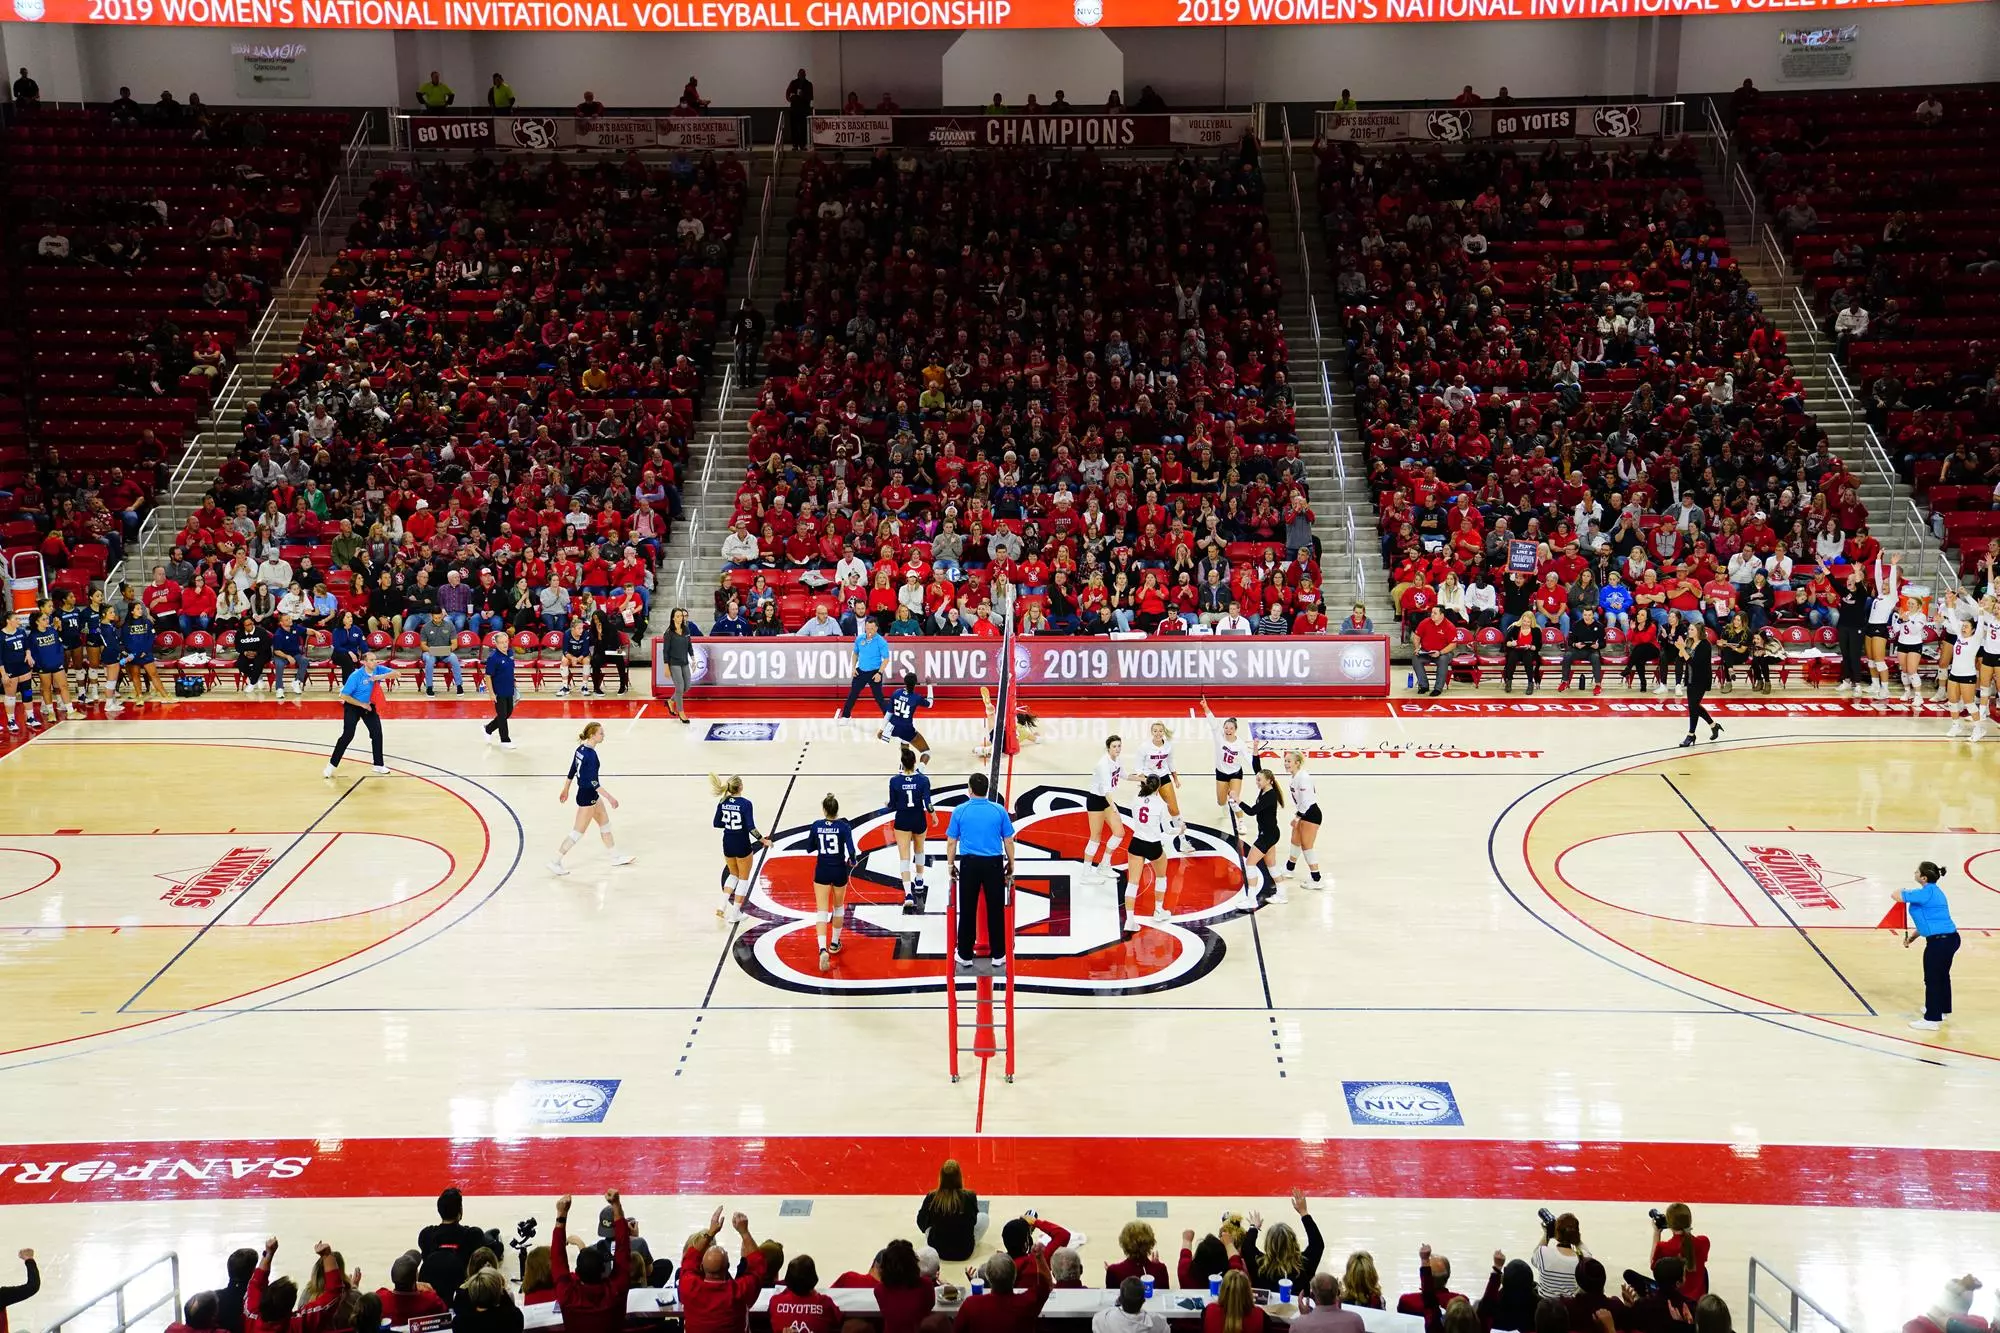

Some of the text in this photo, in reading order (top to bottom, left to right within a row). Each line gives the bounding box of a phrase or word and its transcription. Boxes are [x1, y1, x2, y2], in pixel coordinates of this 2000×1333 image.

[88, 0, 1011, 27] 2019 WOMEN'S NATIONAL INVITATIONAL VOLLEYBALL CHAMPIONSHIP
[1076, 8, 1101, 16] NIVC
[1177, 0, 1240, 22] 2019
[1250, 0, 1378, 21] WOMEN'S
[1386, 0, 1522, 18] NATIONAL
[847, 120, 890, 130] BASKETBALL
[1188, 119, 1233, 129] VOLLEYBALL
[1358, 116, 1400, 125] BASKETBALL
[1497, 111, 1570, 133] GO YOTES
[418, 122, 489, 142] GO YOTES
[611, 123, 653, 132] BASKETBALL
[693, 123, 735, 132] BASKETBALL
[986, 118, 1135, 145] CHAMPIONS
[1350, 127, 1386, 139] 2016-17
[598, 134, 635, 145] 2014-15
[680, 134, 716, 145] 2015-16
[835, 132, 870, 143] 2017-18
[928, 131, 976, 142] SUMMIT
[1200, 130, 1221, 141] 2016
[68, 618, 78, 627] 14
[13, 640, 23, 650] 15
[240, 636, 261, 644] adidas
[722, 650, 786, 680] 2019
[797, 650, 916, 680] WOM'S
[925, 650, 987, 680] NIVC
[1043, 649, 1310, 679] 2019 WOMEN'S NIVC
[1343, 657, 1373, 669] NIVC
[893, 699, 911, 718] 24
[1401, 703, 1955, 712] SANFORD COYOE SPORTS CENTE
[718, 729, 764, 737] NIVC
[1257, 750, 1545, 759] ABOTT COURT
[906, 790, 915, 808] 1
[1138, 807, 1150, 824] 6
[818, 834, 839, 854] 13
[1797, 853, 1823, 869] THE
[173, 847, 267, 907] SUMMIT
[1742, 859, 1785, 895] LEAGUE
[1748, 846, 1841, 908] SUMMIT
[160, 884, 186, 901] THE
[1364, 1100, 1441, 1110] NIVC
[776, 1303, 824, 1314] COYOTES
